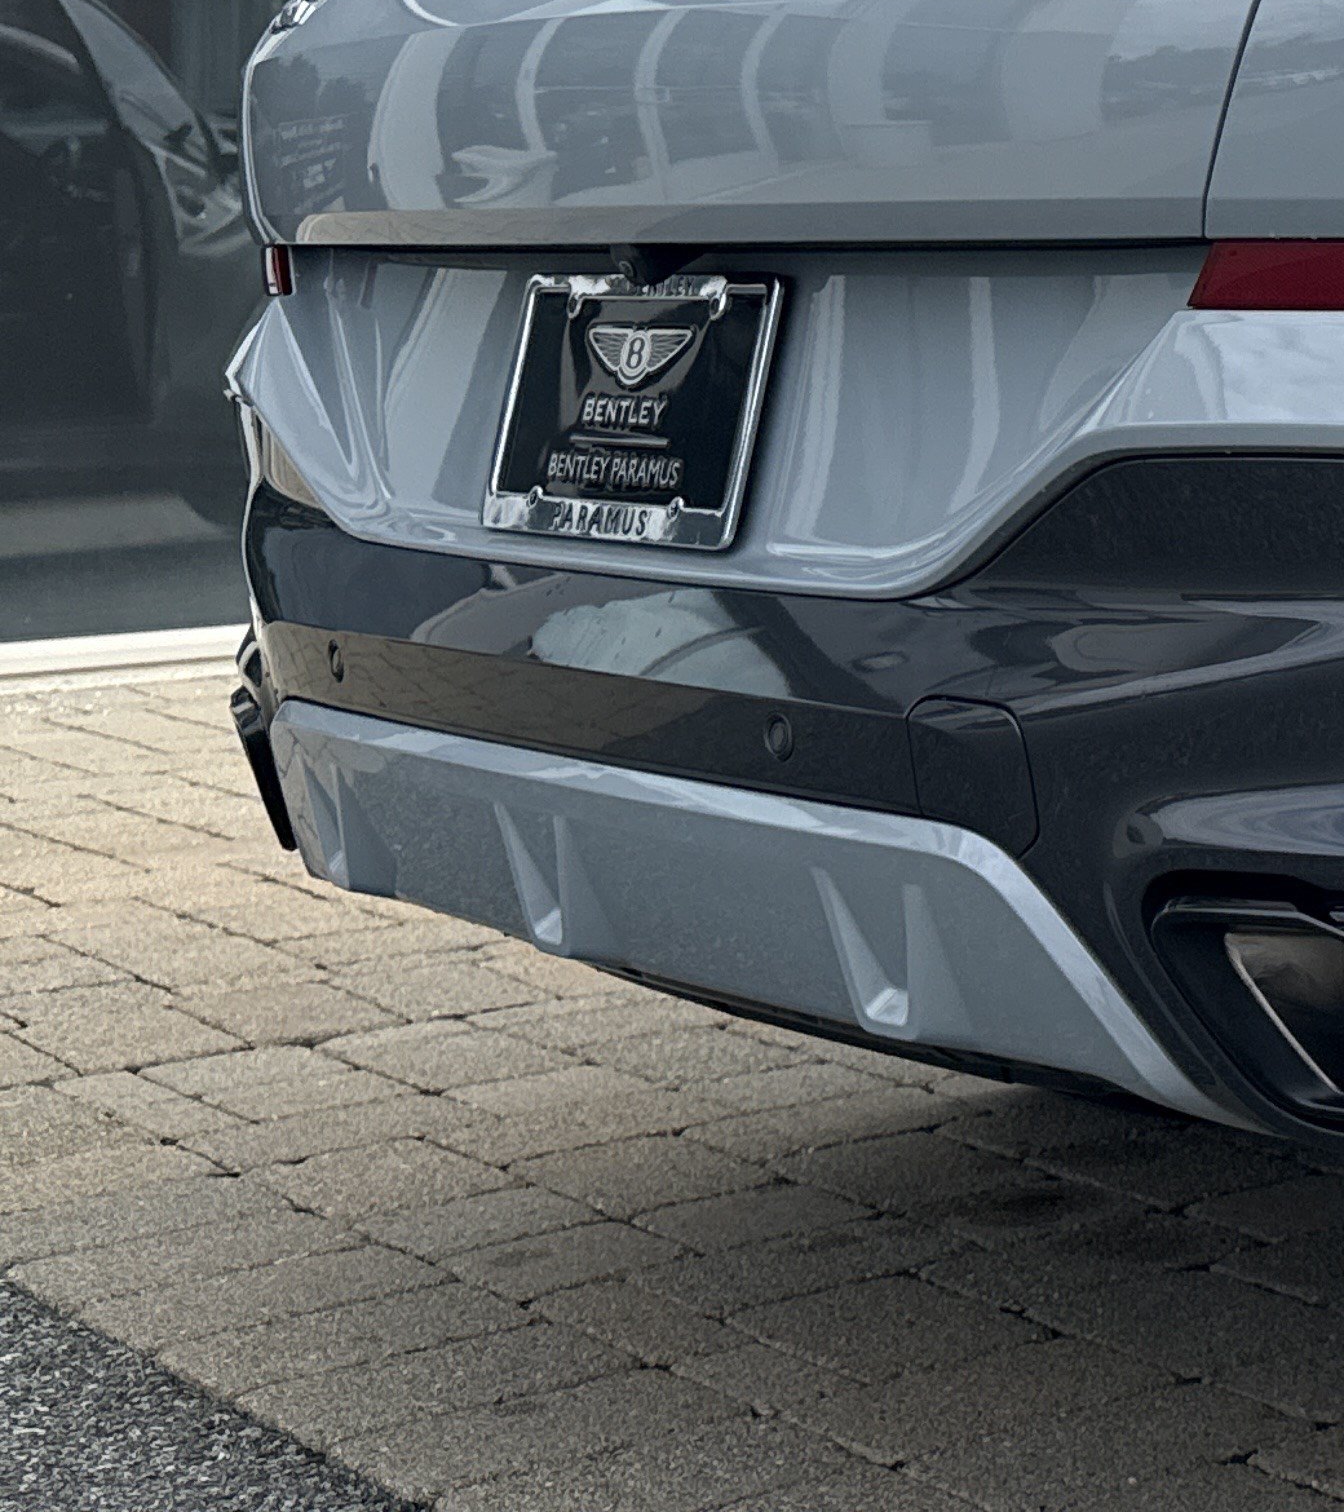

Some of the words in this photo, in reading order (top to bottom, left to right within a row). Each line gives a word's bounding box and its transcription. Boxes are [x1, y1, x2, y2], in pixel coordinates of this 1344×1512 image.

[582, 396, 668, 426] BENTLEY
[548, 452, 609, 478] BENTLEY
[611, 455, 681, 486] PARAMUS
[552, 500, 648, 536] PARAMUS
